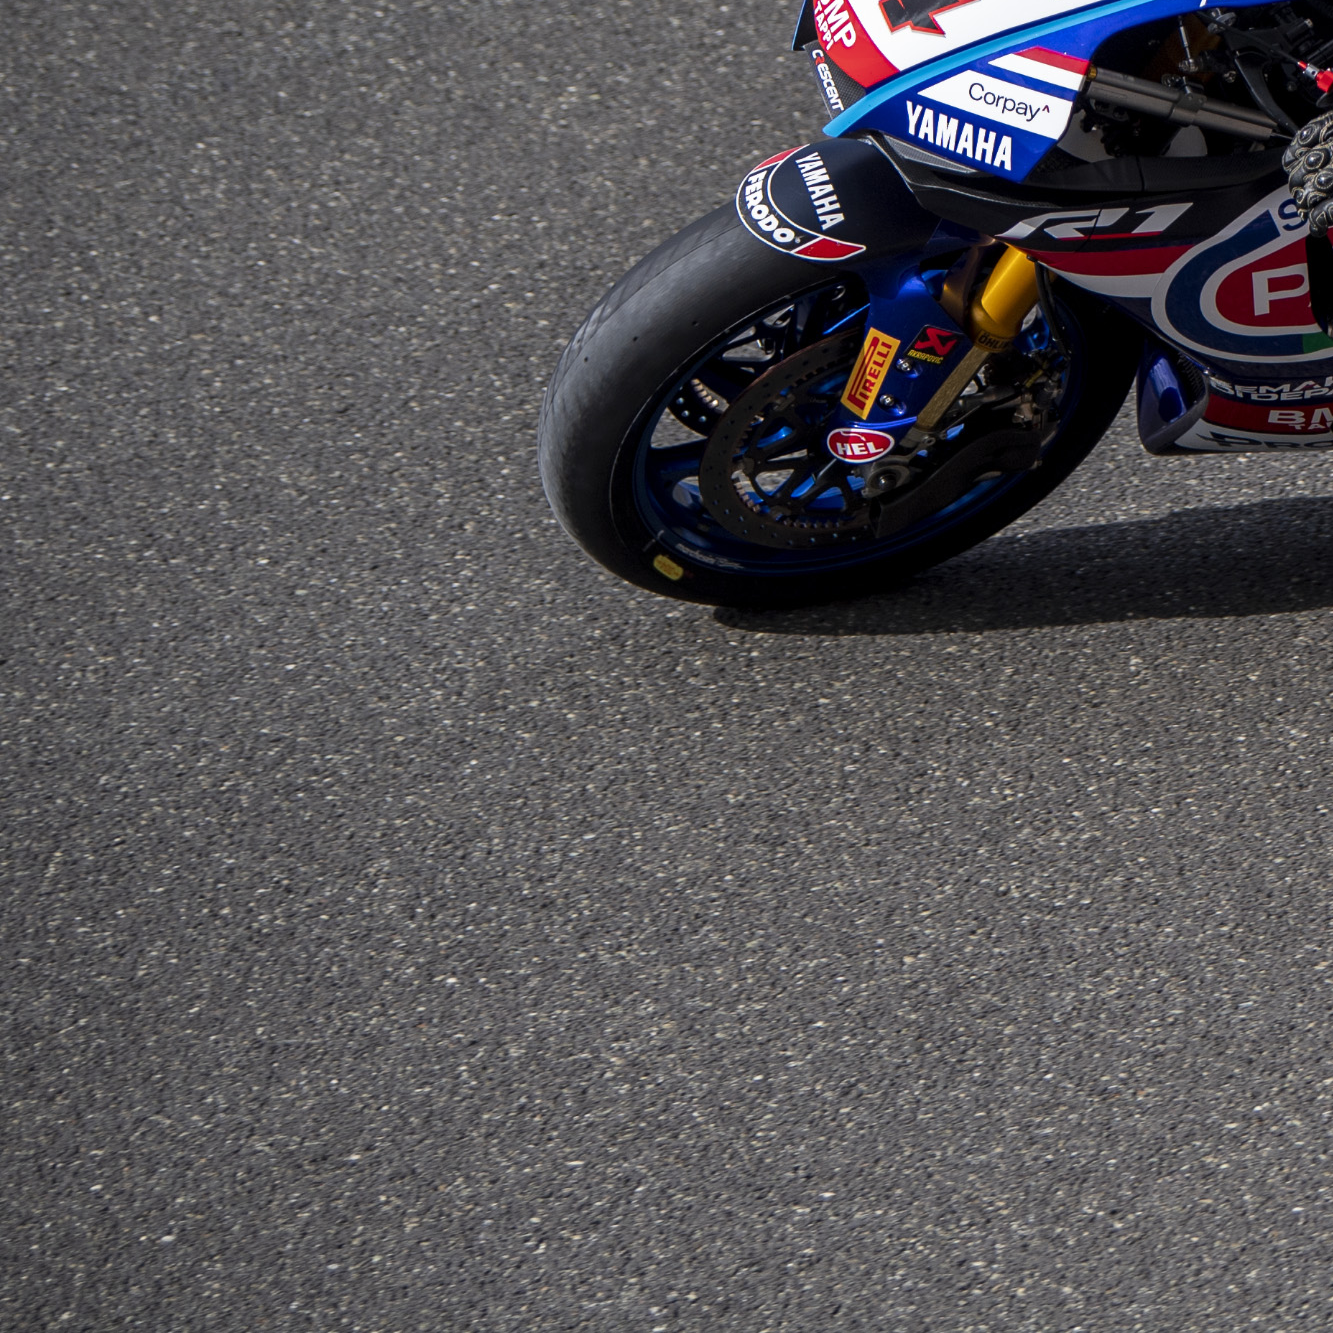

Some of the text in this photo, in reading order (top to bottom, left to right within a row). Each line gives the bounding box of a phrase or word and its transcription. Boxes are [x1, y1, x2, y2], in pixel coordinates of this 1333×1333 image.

[814, 3, 834, 51] TAPPI
[811, 49, 844, 112] CRESCENT
[968, 83, 1041, 122] Corpay
[906, 100, 1012, 171] YAMAHA
[745, 171, 795, 243] FERODO
[795, 152, 845, 230] YAMAHA
[848, 337, 892, 411] PIRELLI
[836, 441, 884, 457] HEL
